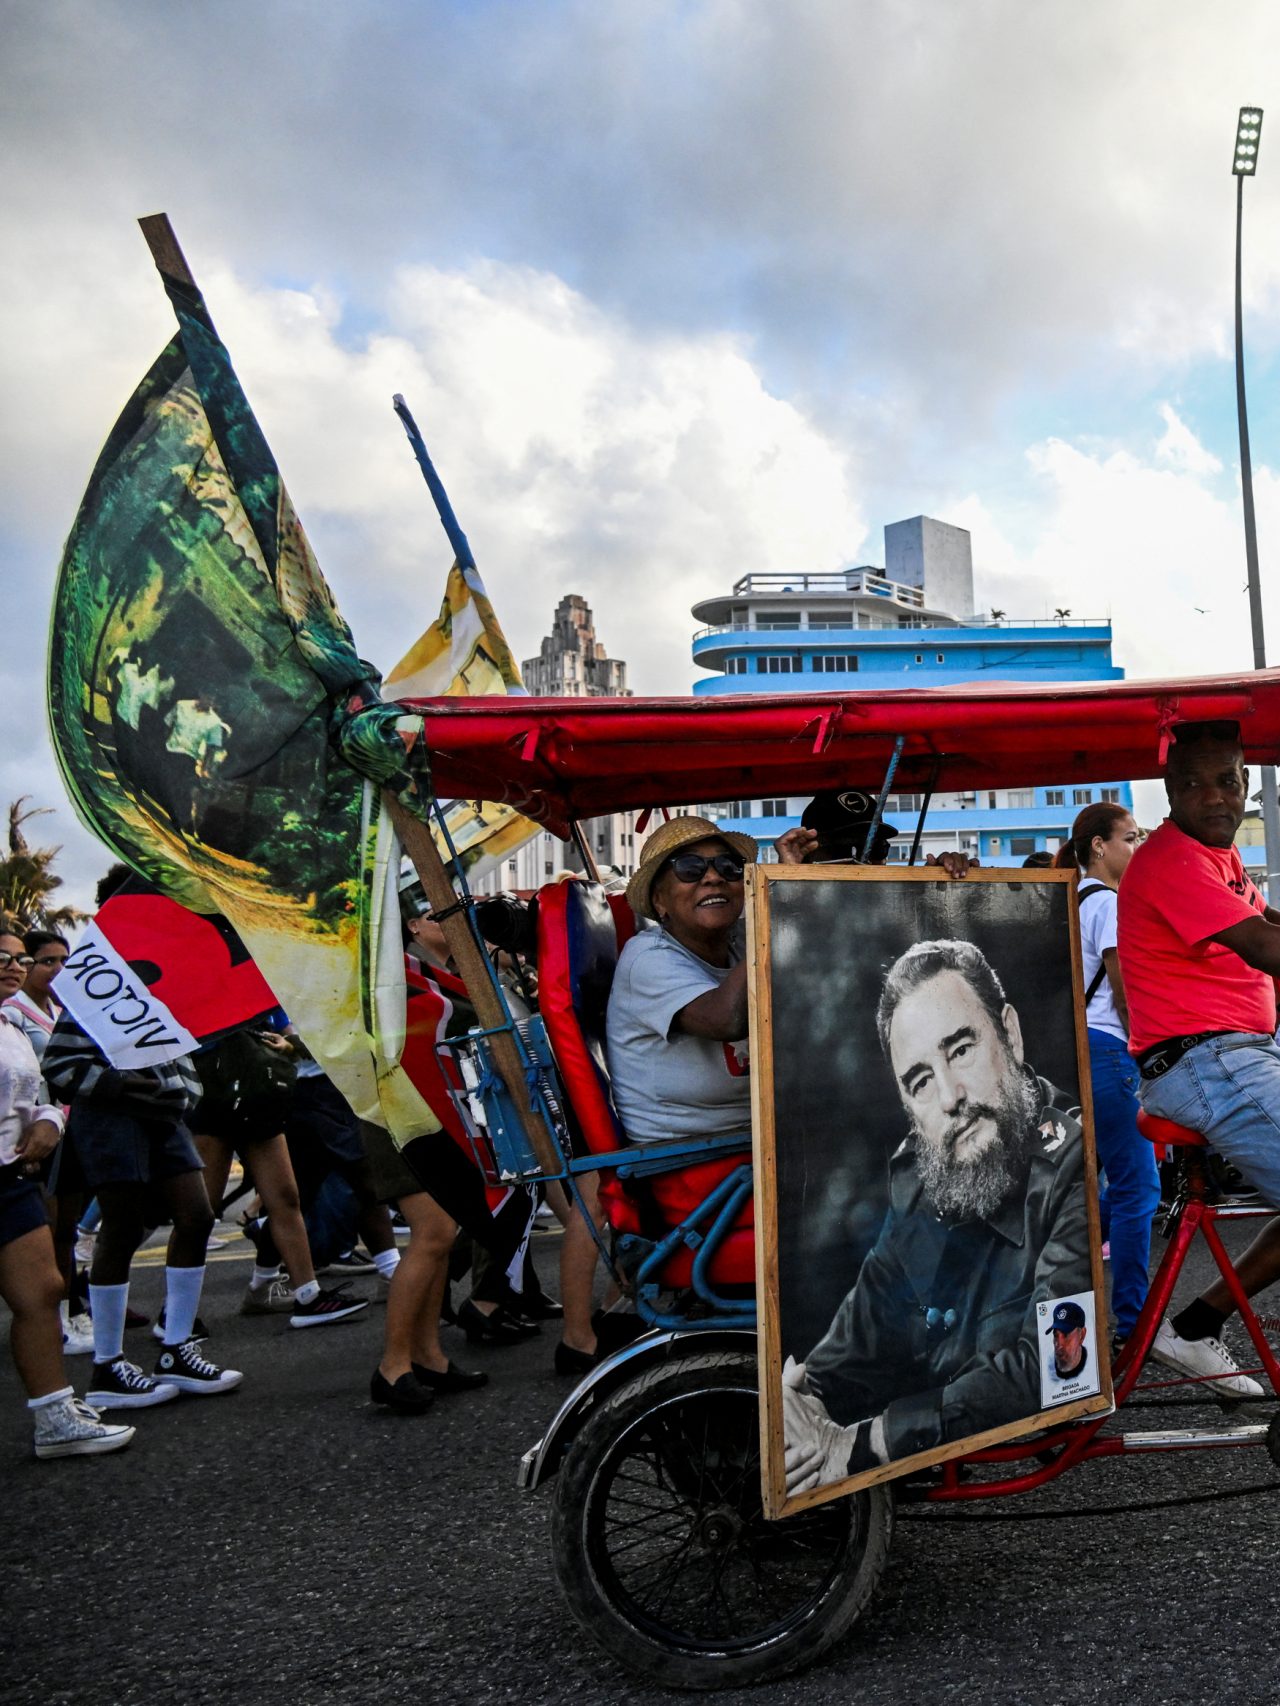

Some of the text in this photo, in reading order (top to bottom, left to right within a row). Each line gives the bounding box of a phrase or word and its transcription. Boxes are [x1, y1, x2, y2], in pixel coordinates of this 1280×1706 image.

[1052, 1384, 1091, 1400] MARTHA MACHADO
[1062, 1382, 1080, 1392] BRIGADA
